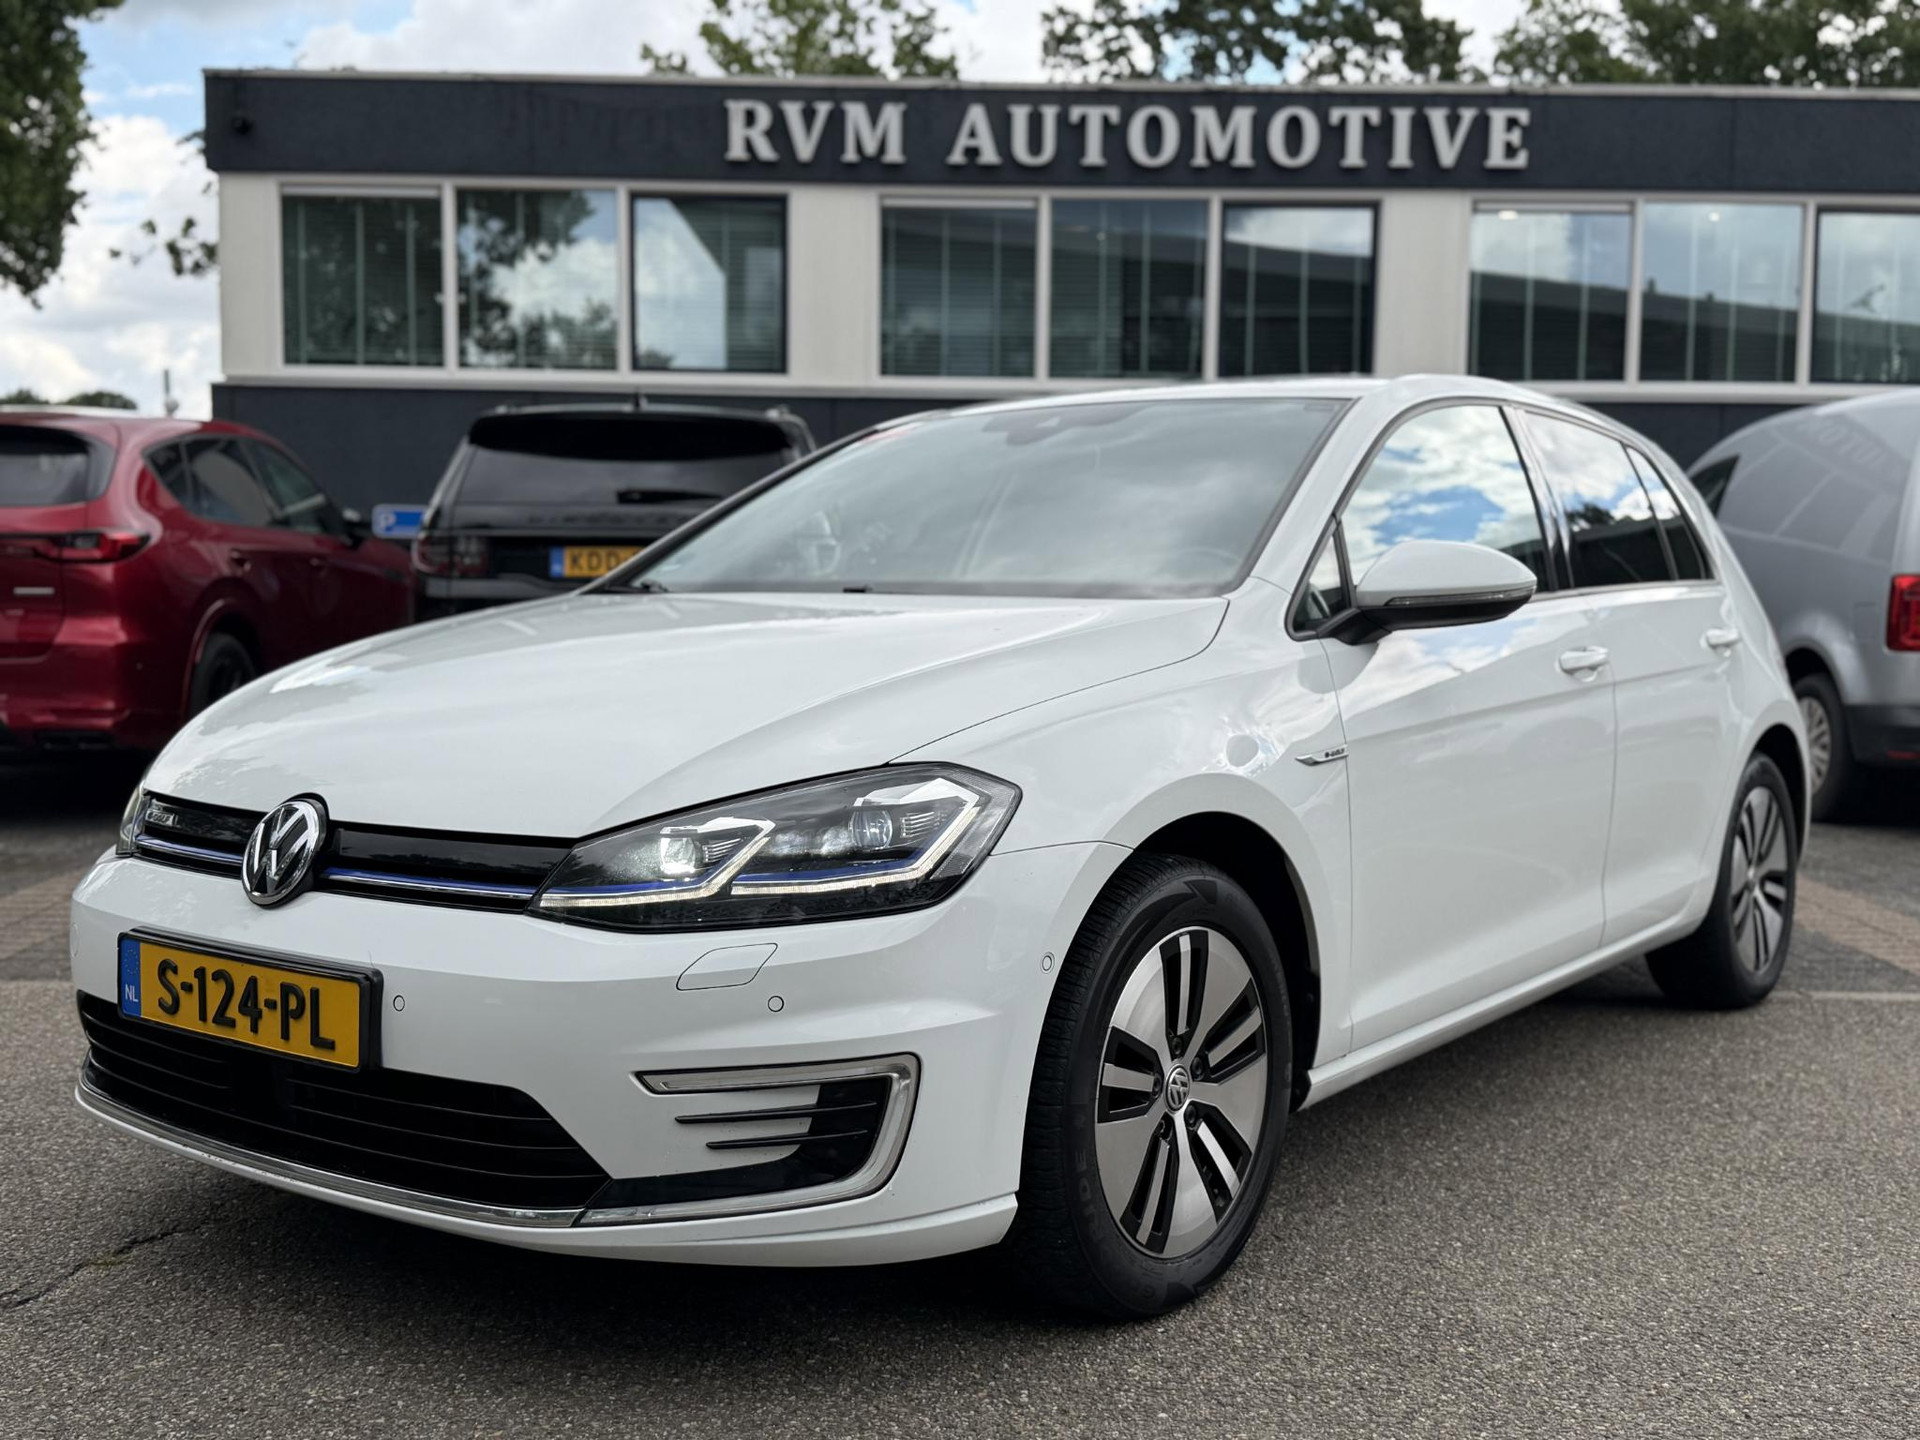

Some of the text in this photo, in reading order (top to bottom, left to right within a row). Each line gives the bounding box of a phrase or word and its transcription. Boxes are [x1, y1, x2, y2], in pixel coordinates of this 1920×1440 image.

[725, 99, 1530, 168] RVM AUTOMOTIVE
[125, 984, 139, 1003] NL
[158, 959, 336, 1050] S-124-PL
